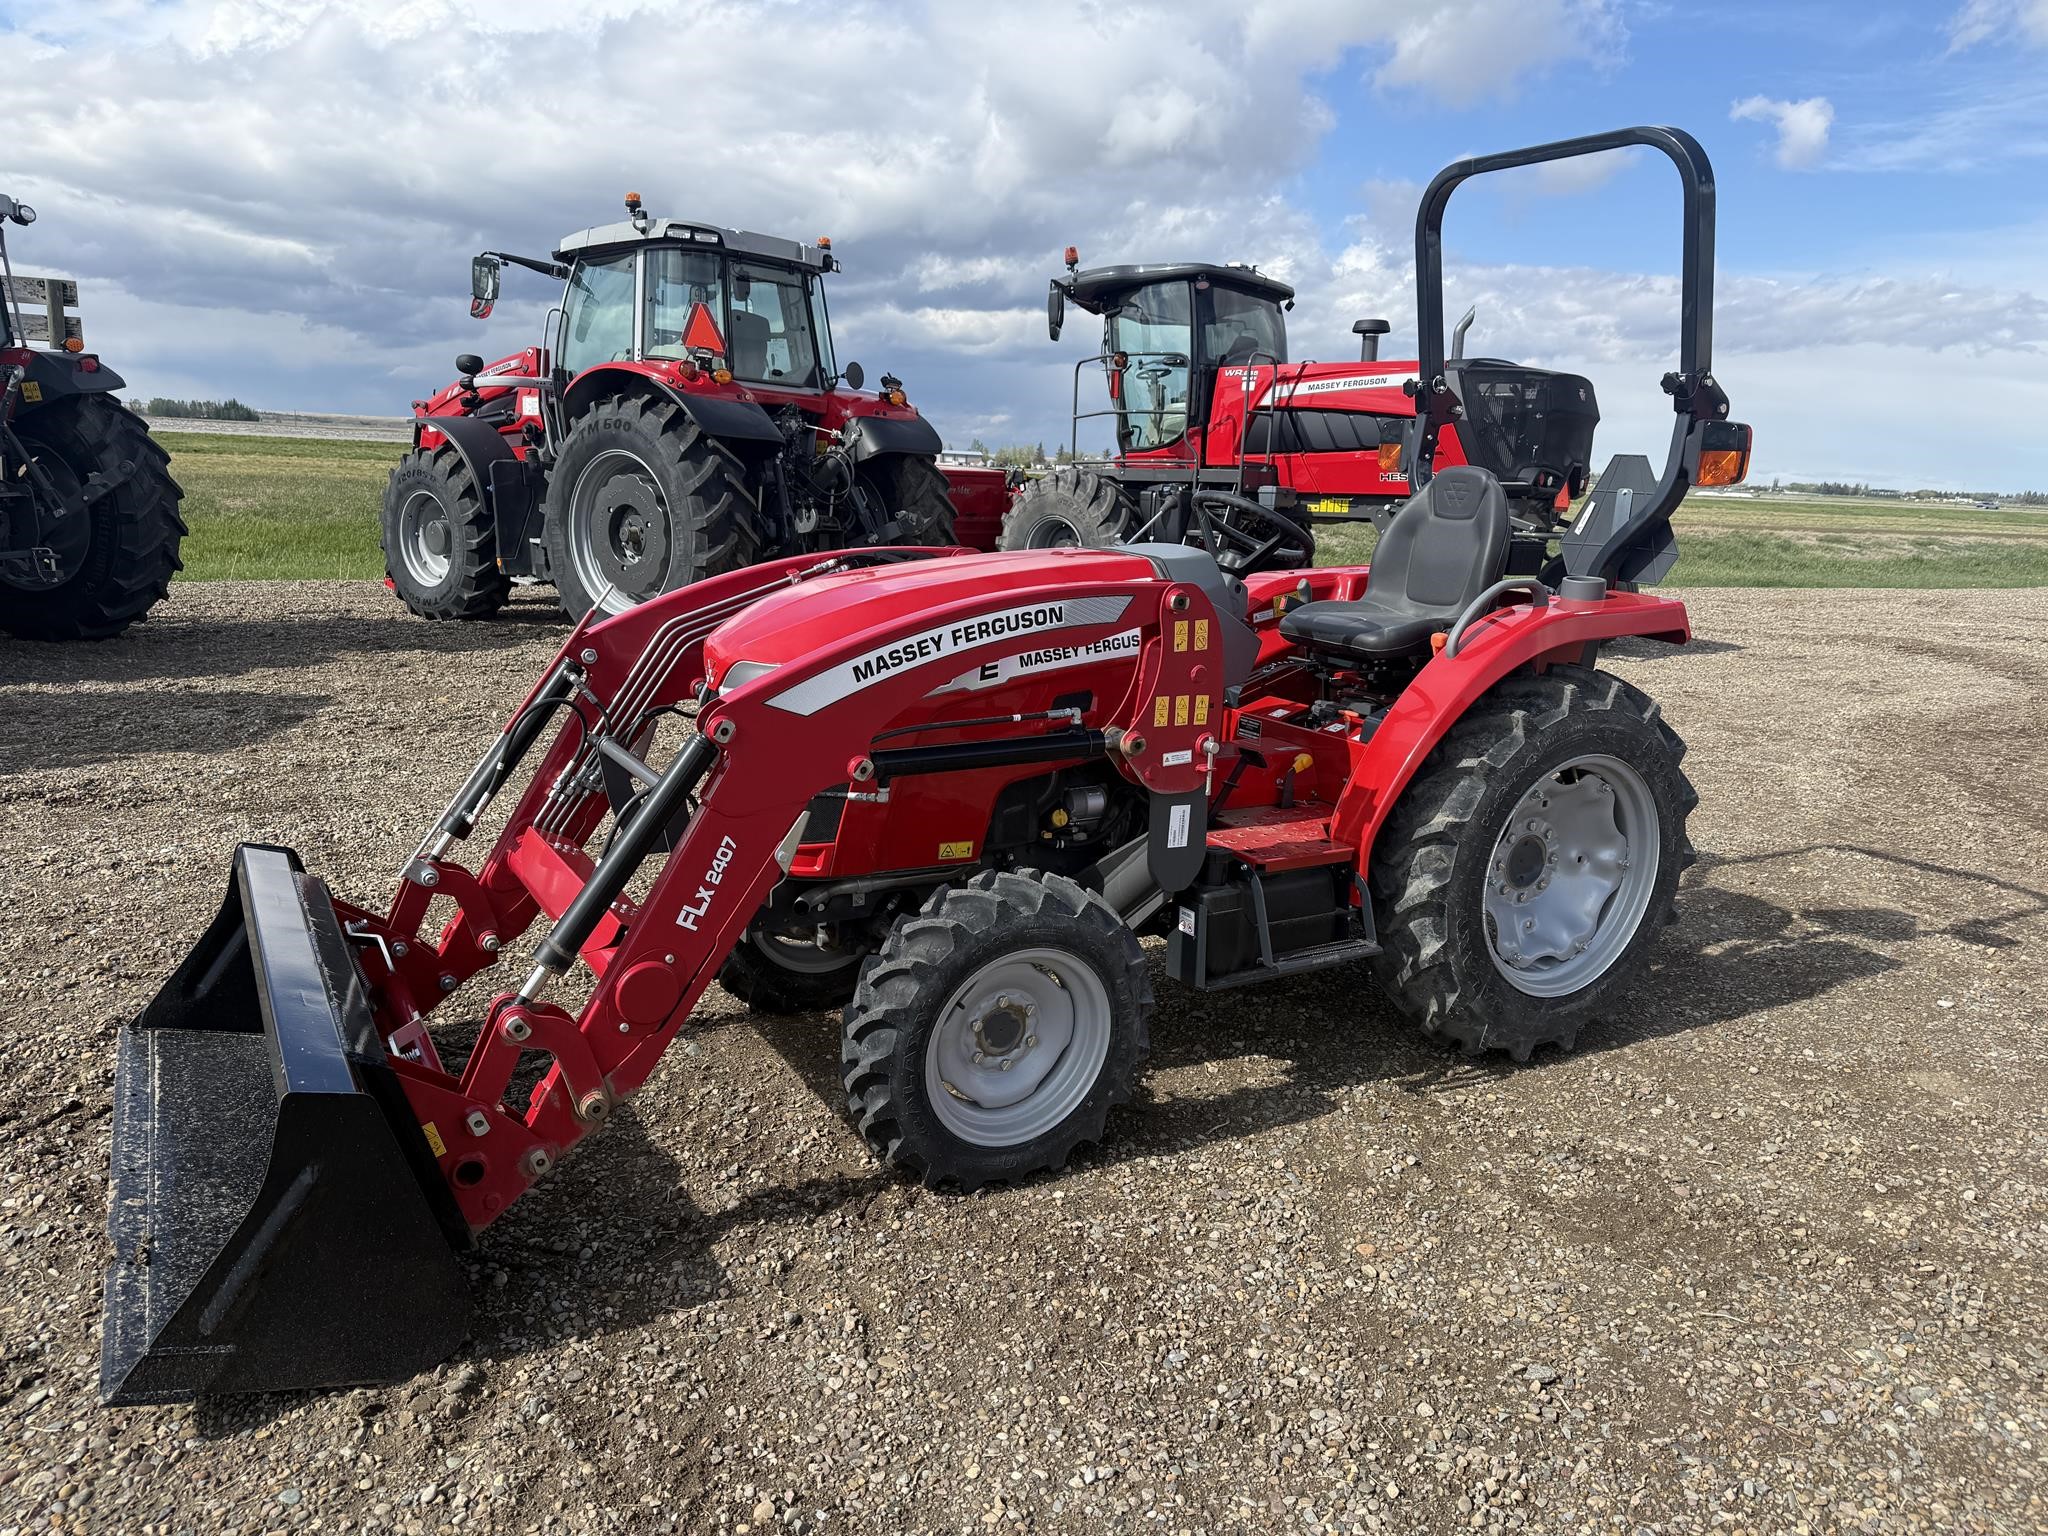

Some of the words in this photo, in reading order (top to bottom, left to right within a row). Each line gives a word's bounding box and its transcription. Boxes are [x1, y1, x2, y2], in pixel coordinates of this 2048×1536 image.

[1307, 381, 1341, 391] MASSEY
[1342, 377, 1388, 388] FERGUSON
[579, 423, 599, 441] TM
[604, 418, 632, 432] 600
[852, 633, 944, 683] MASSEY
[951, 605, 1064, 647] FERGUSON
[1019, 646, 1080, 668] MASSEY
[1085, 634, 1140, 655] FERGUS
[675, 885, 715, 932] FLX
[705, 835, 737, 885] 2407
